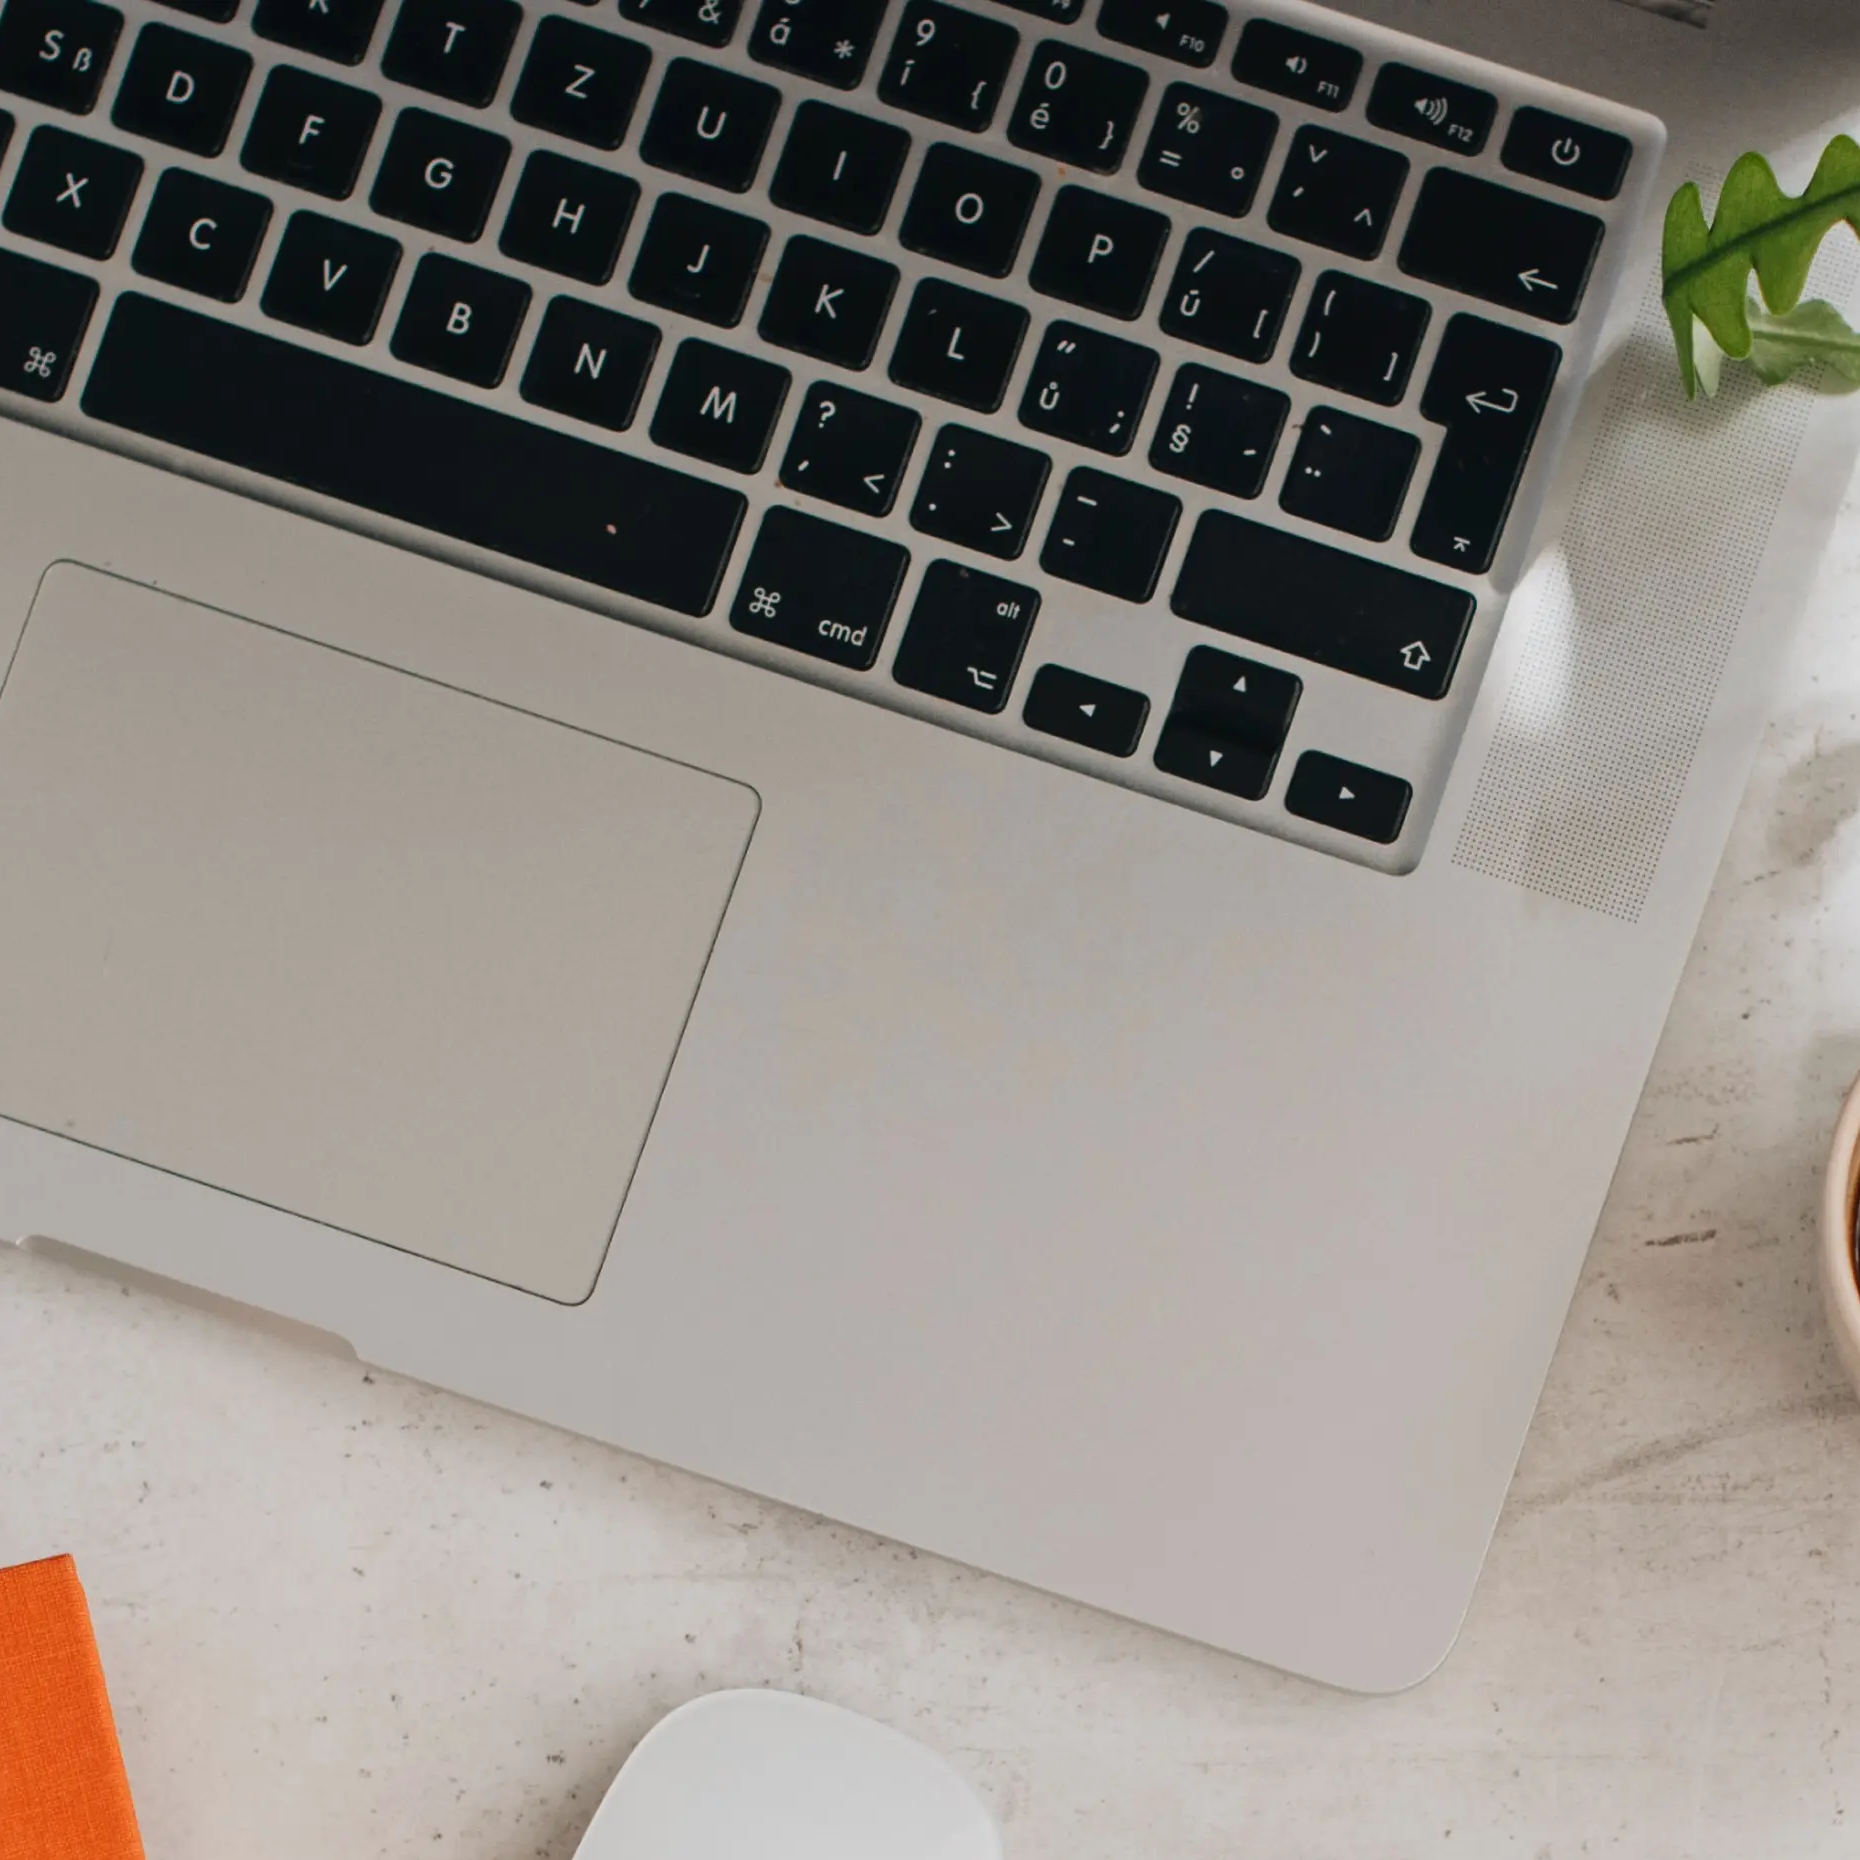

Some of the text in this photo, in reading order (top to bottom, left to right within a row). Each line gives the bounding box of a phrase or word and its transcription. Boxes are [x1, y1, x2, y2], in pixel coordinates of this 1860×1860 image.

[39, 29, 64, 61] S
[444, 21, 466, 54] T
[769, 17, 791, 45] á
[916, 19, 936, 46] 9
[1178, 34, 1205, 53] F10
[72, 47, 92, 72] ß
[900, 59, 915, 86] í
[166, 70, 195, 103] D
[565, 64, 595, 99] Z
[1044, 61, 1067, 90] 0
[1316, 80, 1341, 100] F11
[299, 115, 325, 144] F
[696, 106, 727, 140] U
[1030, 102, 1050, 130] é
[1447, 122, 1474, 143] F12
[424, 157, 454, 189] G
[833, 150, 847, 181] I
[56, 172, 88, 208] X
[552, 198, 585, 234] H
[955, 192, 984, 224] O
[189, 217, 217, 250] C
[1087, 234, 1114, 264] P
[686, 244, 710, 273] J
[323, 259, 348, 291] V
[814, 284, 844, 319] K
[1180, 289, 1201, 317] ú
[446, 302, 472, 335] B
[947, 327, 964, 361] L
[574, 343, 607, 380] N
[700, 386, 737, 424] M
[1039, 381, 1060, 410] ů
[996, 602, 1021, 619] alt
[818, 619, 868, 647] cmd
